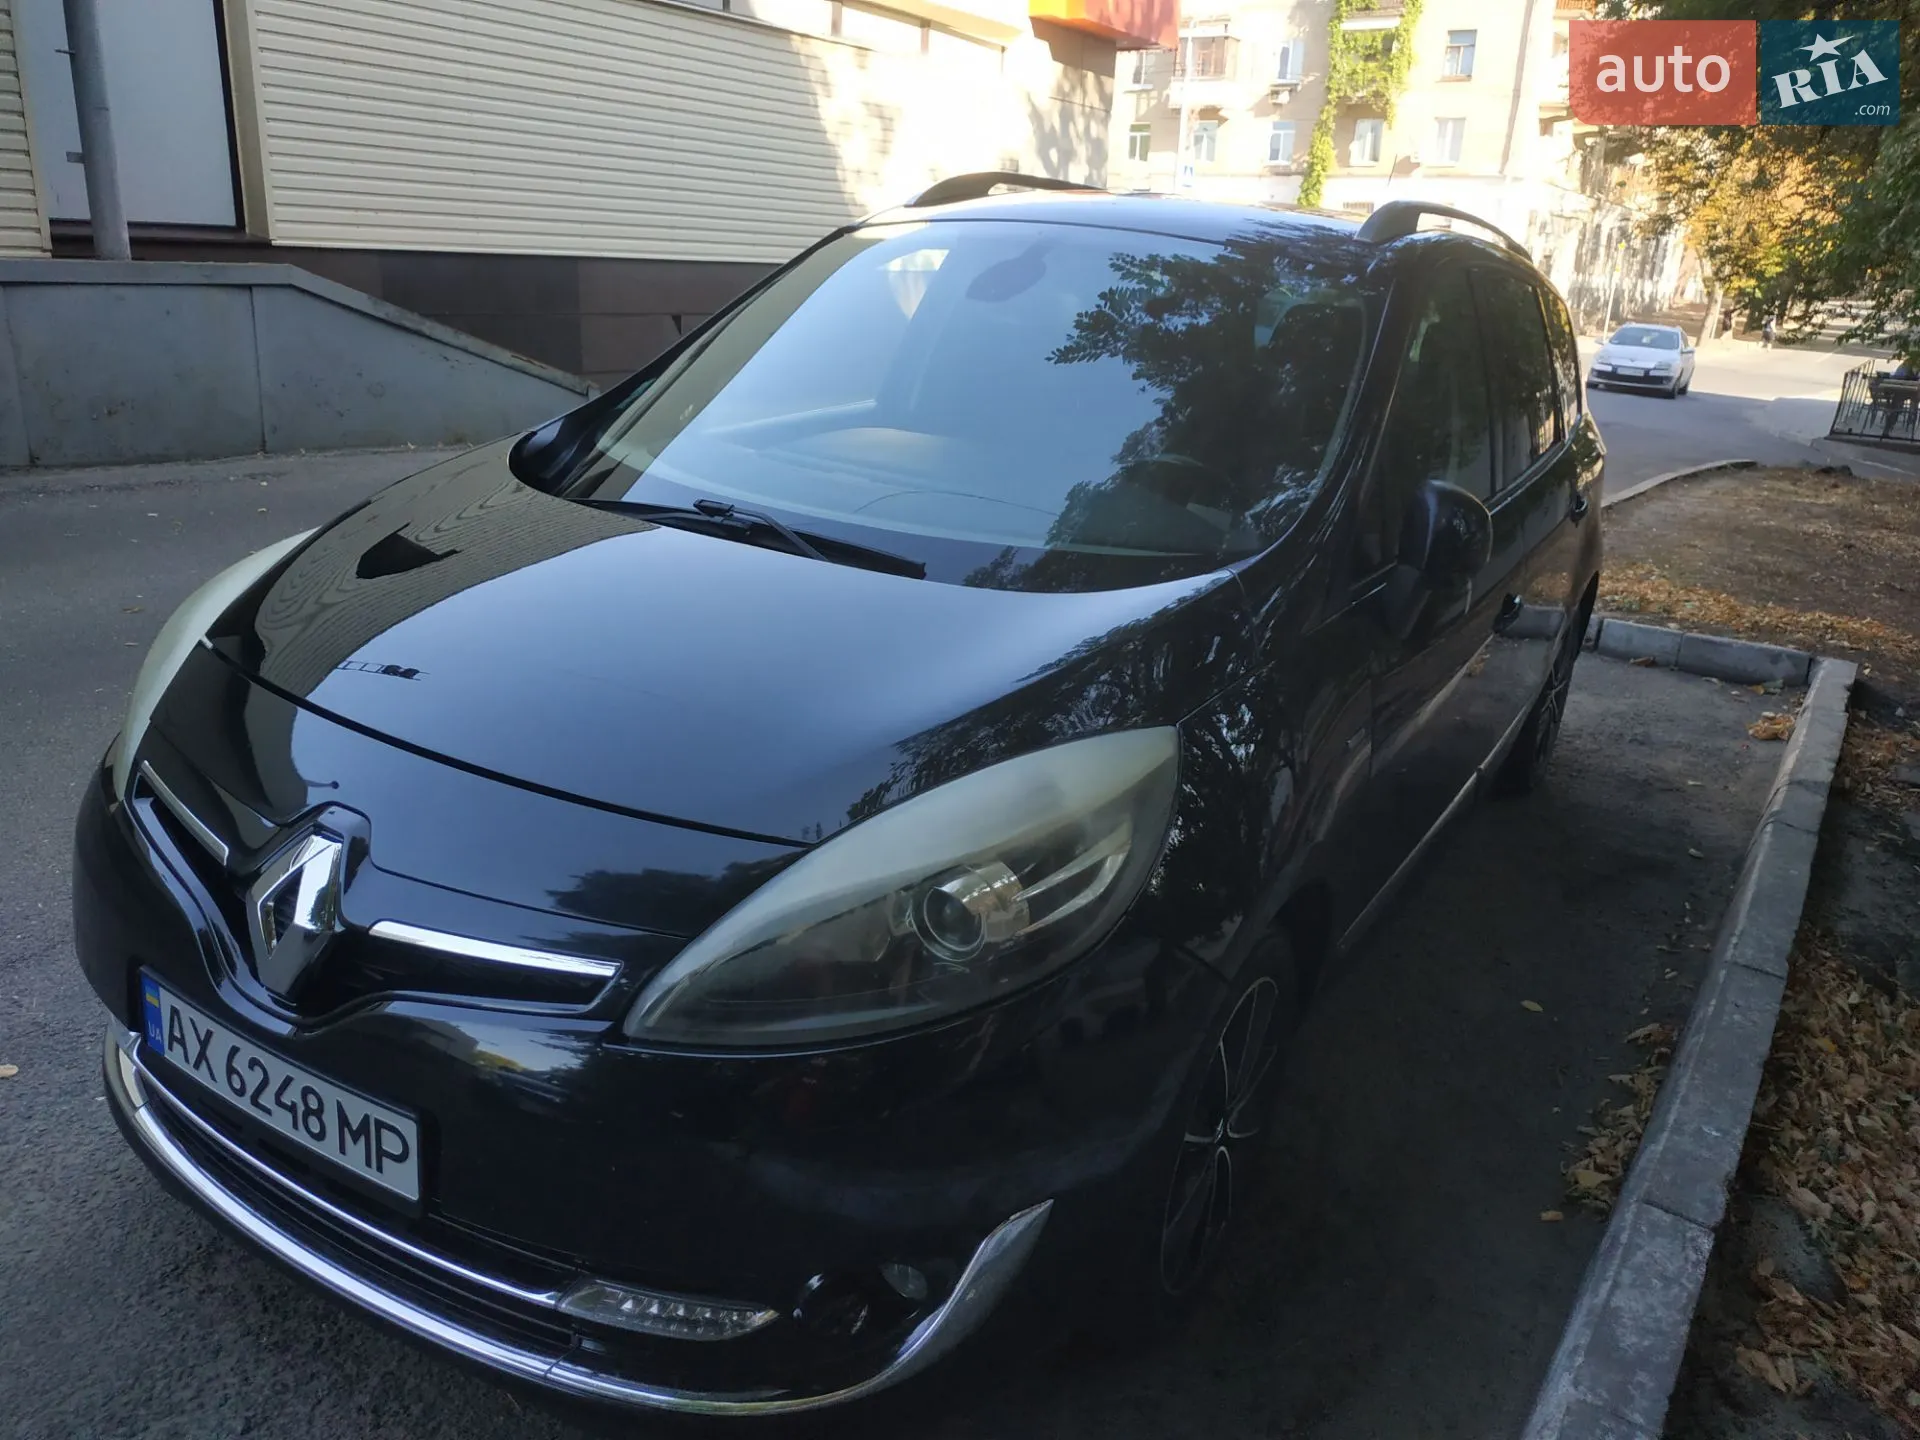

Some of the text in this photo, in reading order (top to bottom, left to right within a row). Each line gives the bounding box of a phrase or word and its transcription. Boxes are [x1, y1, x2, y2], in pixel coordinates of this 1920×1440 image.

[167, 1004, 410, 1174] AX 6248 MP
